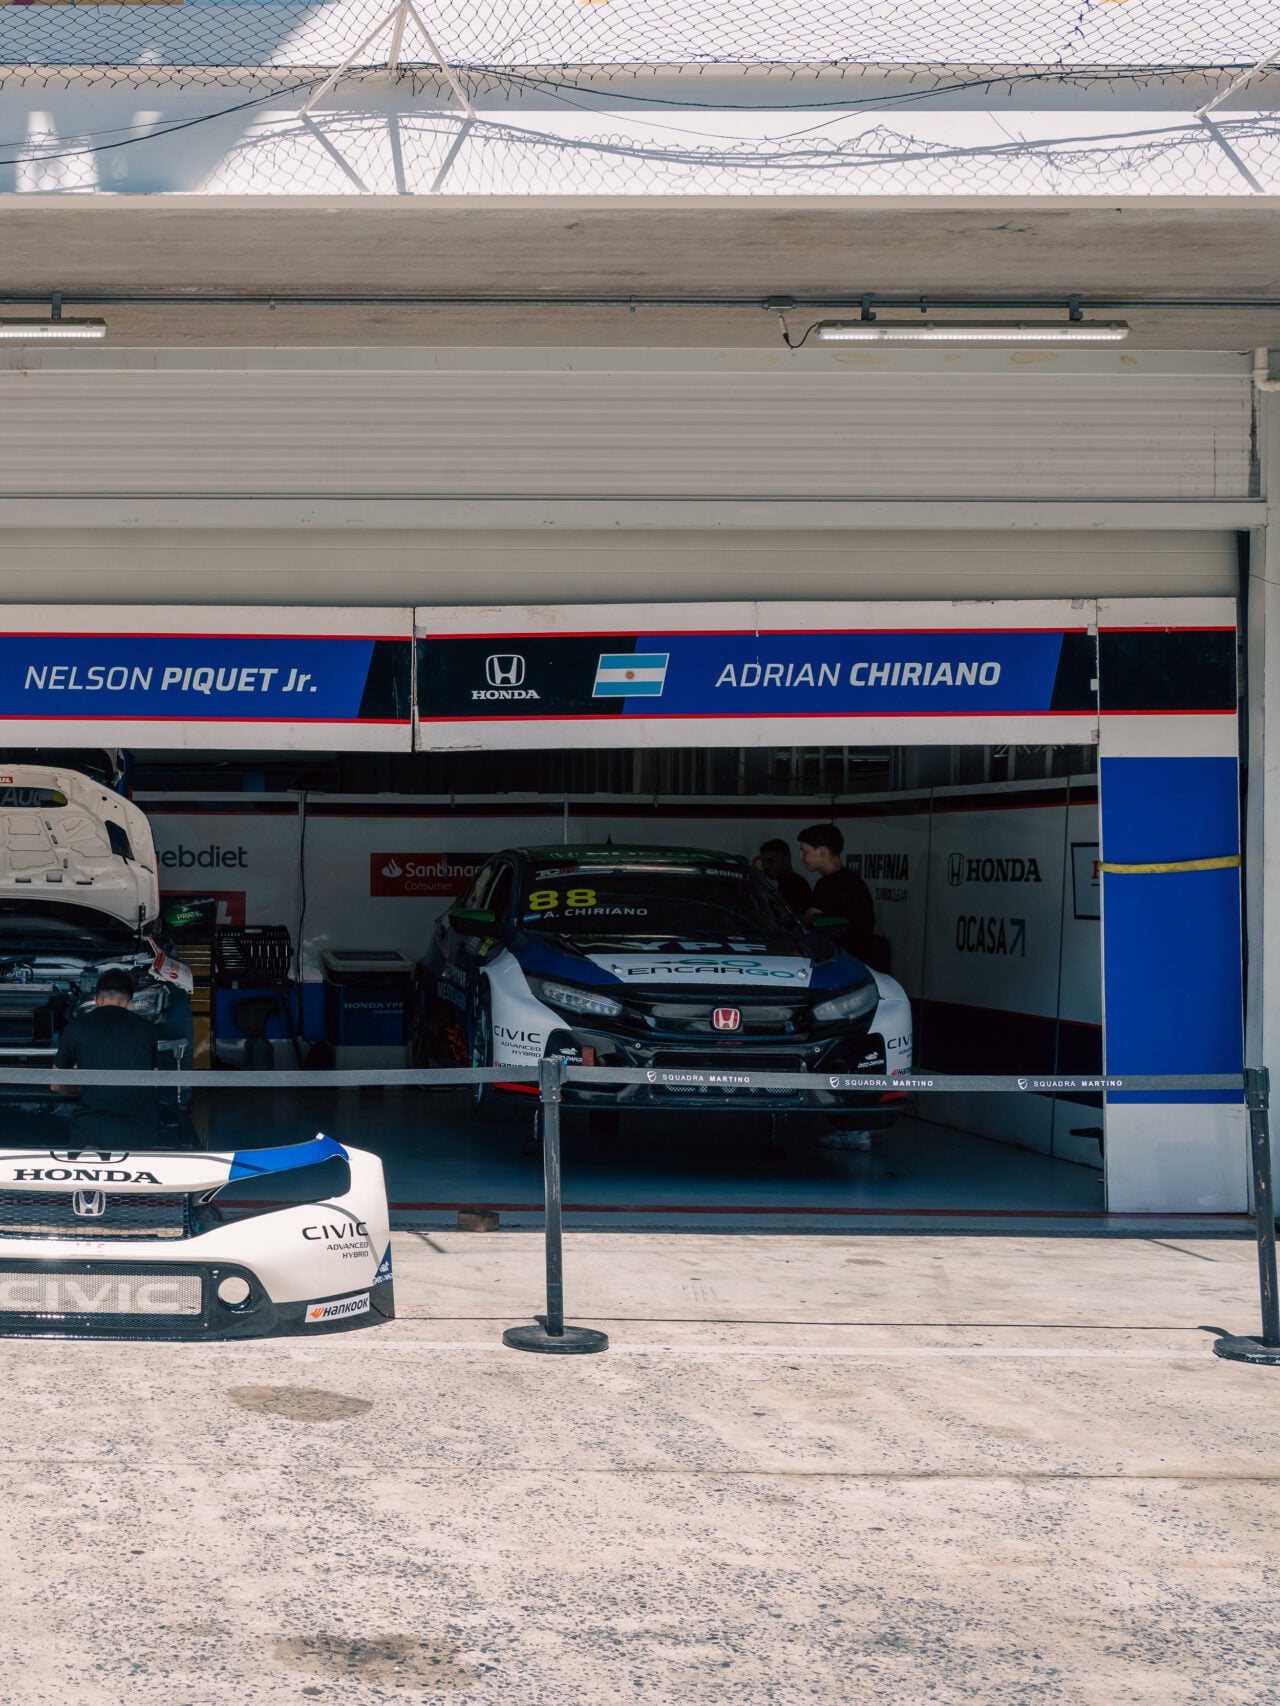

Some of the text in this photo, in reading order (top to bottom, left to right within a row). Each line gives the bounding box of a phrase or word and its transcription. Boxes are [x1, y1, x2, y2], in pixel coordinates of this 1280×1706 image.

[24, 665, 318, 695] NELSON PIQUET Jr.
[714, 662, 1002, 687] ADRIAN CHIRIANO
[471, 690, 541, 700] HONDA
[157, 845, 249, 868] ebdiet
[863, 853, 909, 881] INFINIA
[966, 858, 1043, 883] HONDA
[404, 880, 455, 892] Consumer
[528, 888, 598, 911] 88
[543, 907, 649, 919] A. CHIRIANO
[956, 914, 1008, 956] OCASA
[623, 941, 768, 952] YPF
[493, 1025, 541, 1044] CIVIC
[887, 1035, 912, 1050] CIV
[662, 1074, 751, 1083] SQUADRA MARTINO
[845, 1079, 887, 1087] SQUADRA
[12, 1168, 163, 1185] HONDA
[301, 1221, 369, 1241] CIVIC
[326, 1241, 369, 1252] ADVANCED
[342, 1250, 369, 1260] HYBRID
